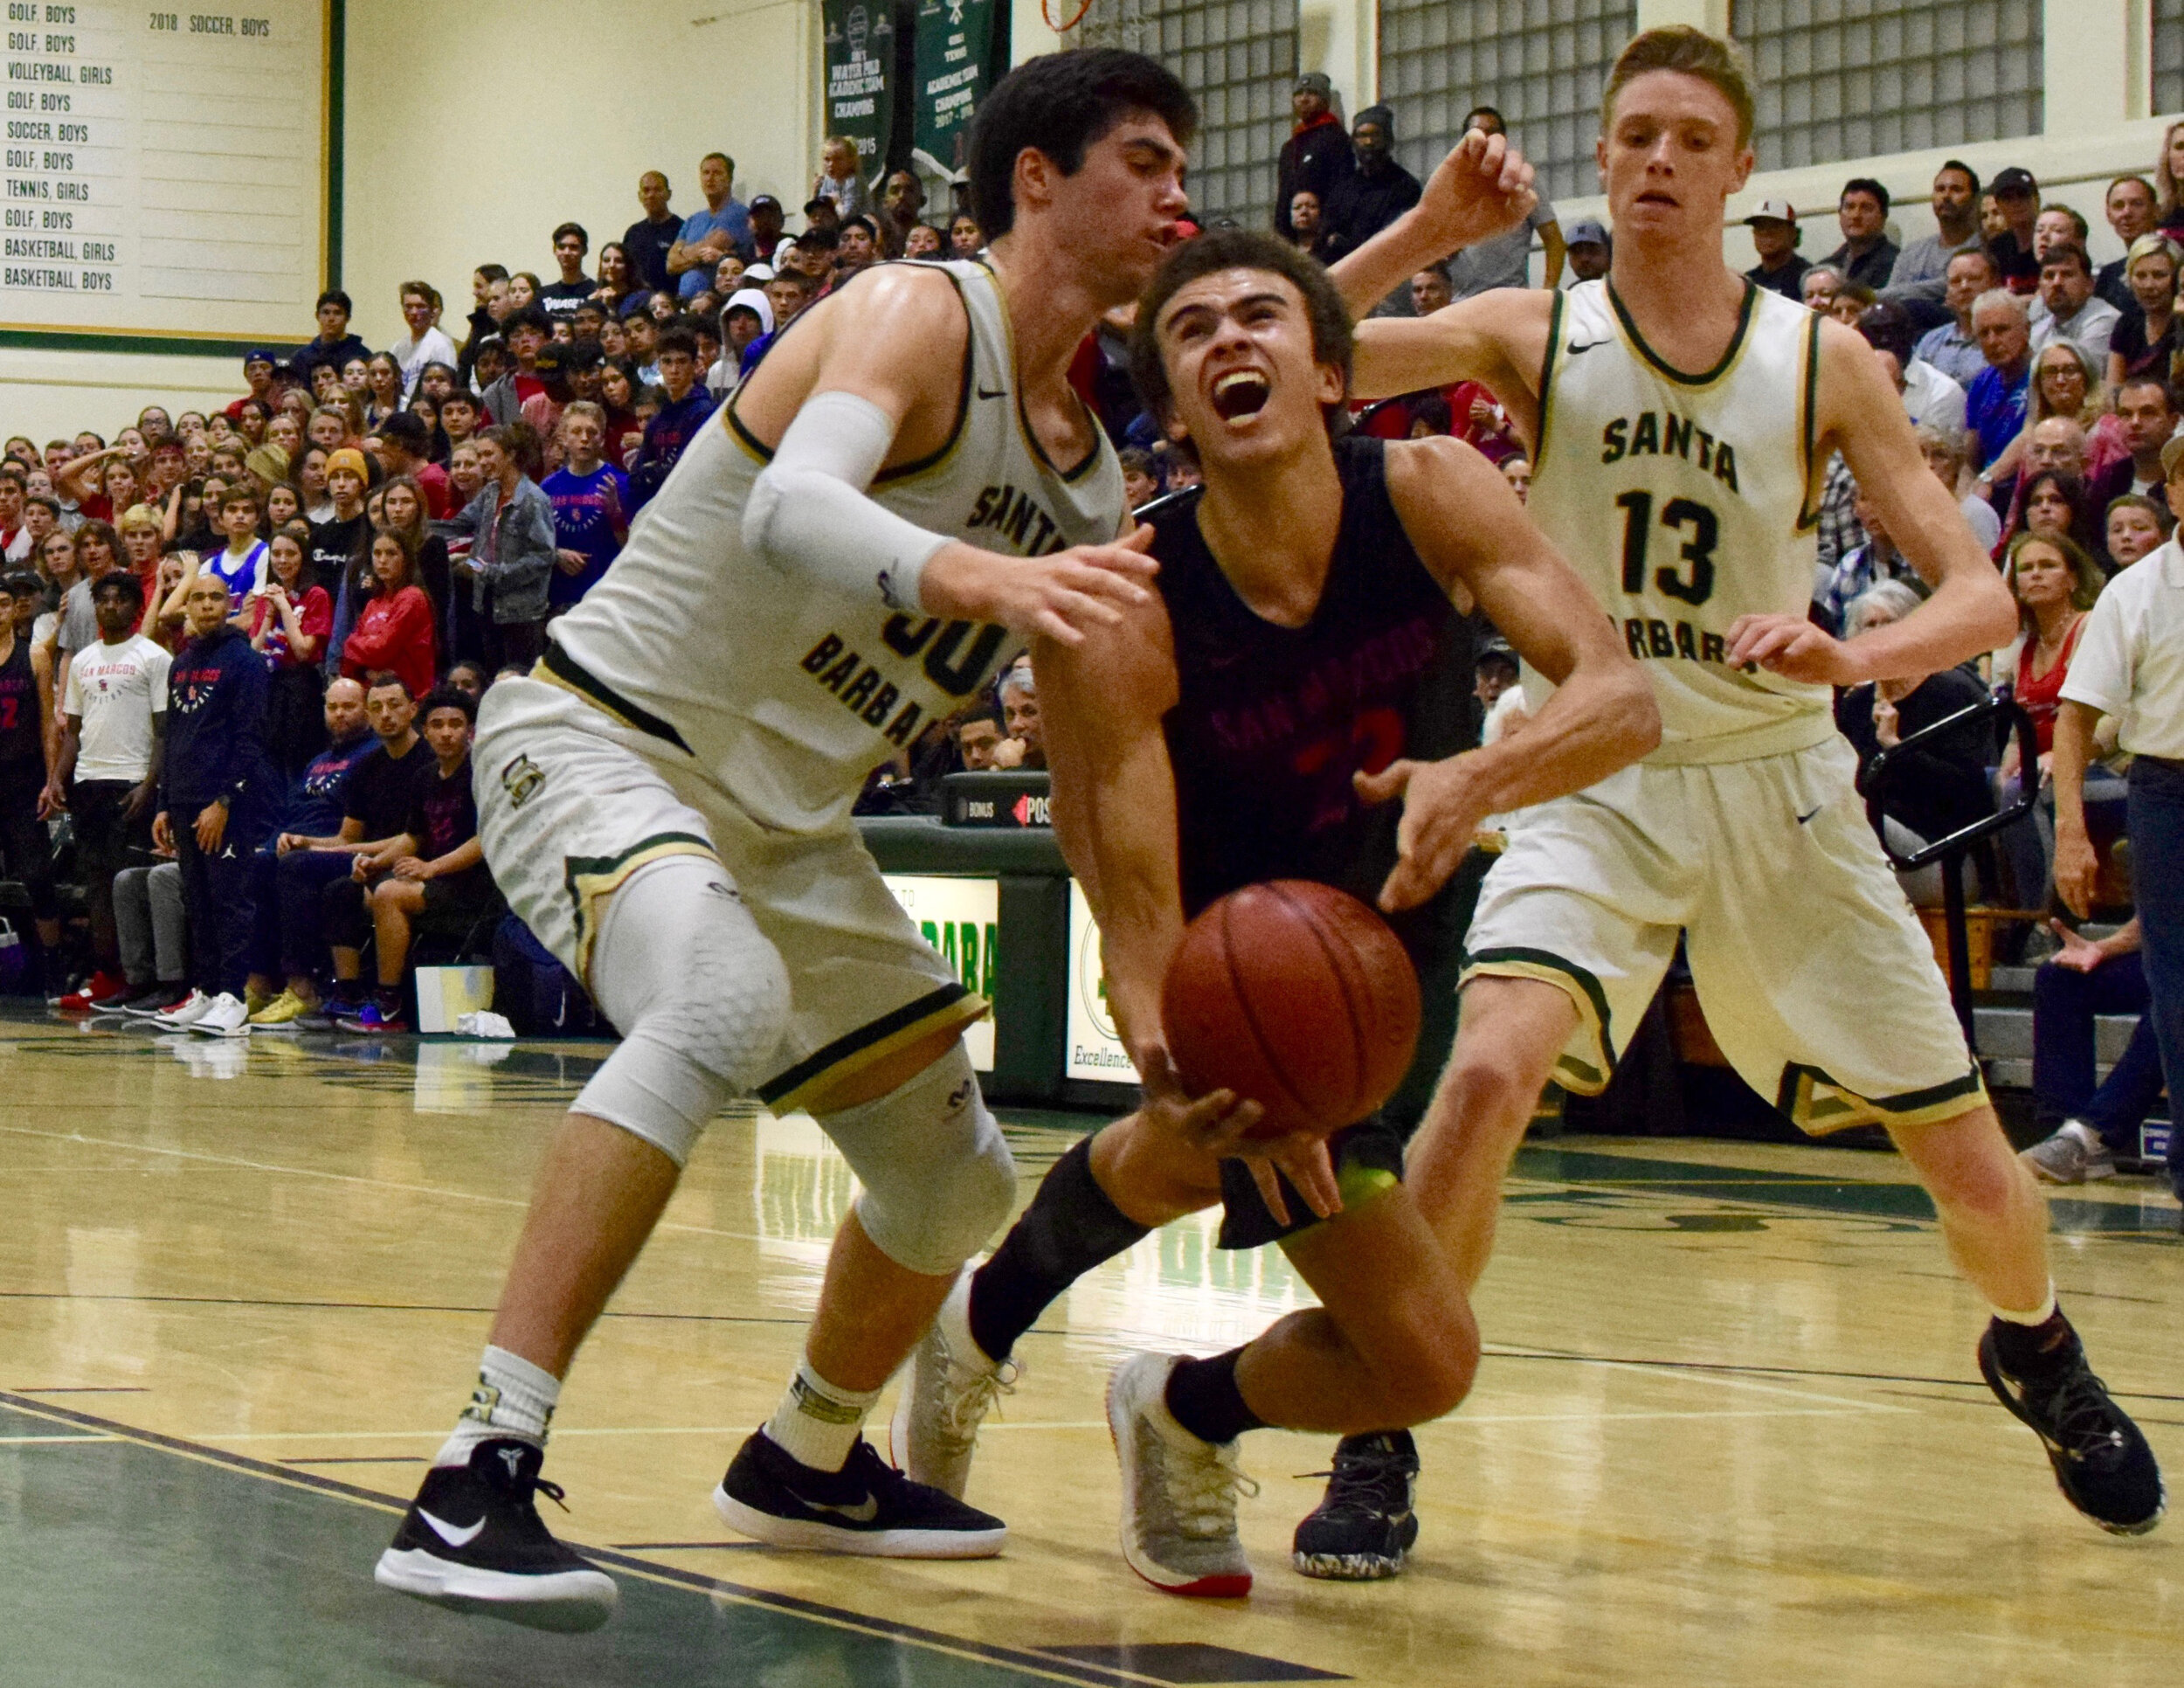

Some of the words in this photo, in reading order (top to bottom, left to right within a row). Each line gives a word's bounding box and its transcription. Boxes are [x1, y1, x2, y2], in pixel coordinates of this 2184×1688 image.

[45, 6, 75, 24] BOYS
[150, 12, 177, 31] 2018
[242, 17, 269, 37] BOYS
[45, 35, 75, 53] BOYS
[80, 66, 112, 85] GIRLS
[41, 93, 71, 112] BOYS
[59, 124, 88, 142] BOYS
[44, 152, 73, 170] BOYS
[57, 182, 89, 201] GIRLS
[43, 211, 73, 229] BOYS
[83, 243, 114, 261] GIRLS
[82, 271, 112, 290] BOYS
[1602, 412, 1738, 494] SANTA
[1616, 490, 1718, 606] 13
[1607, 614, 1758, 674] RBAR
[97, 664, 136, 675] MARCOS
[798, 633, 937, 751] BARBA
[969, 801, 994, 818] BONUS
[1026, 796, 1052, 824] POS
